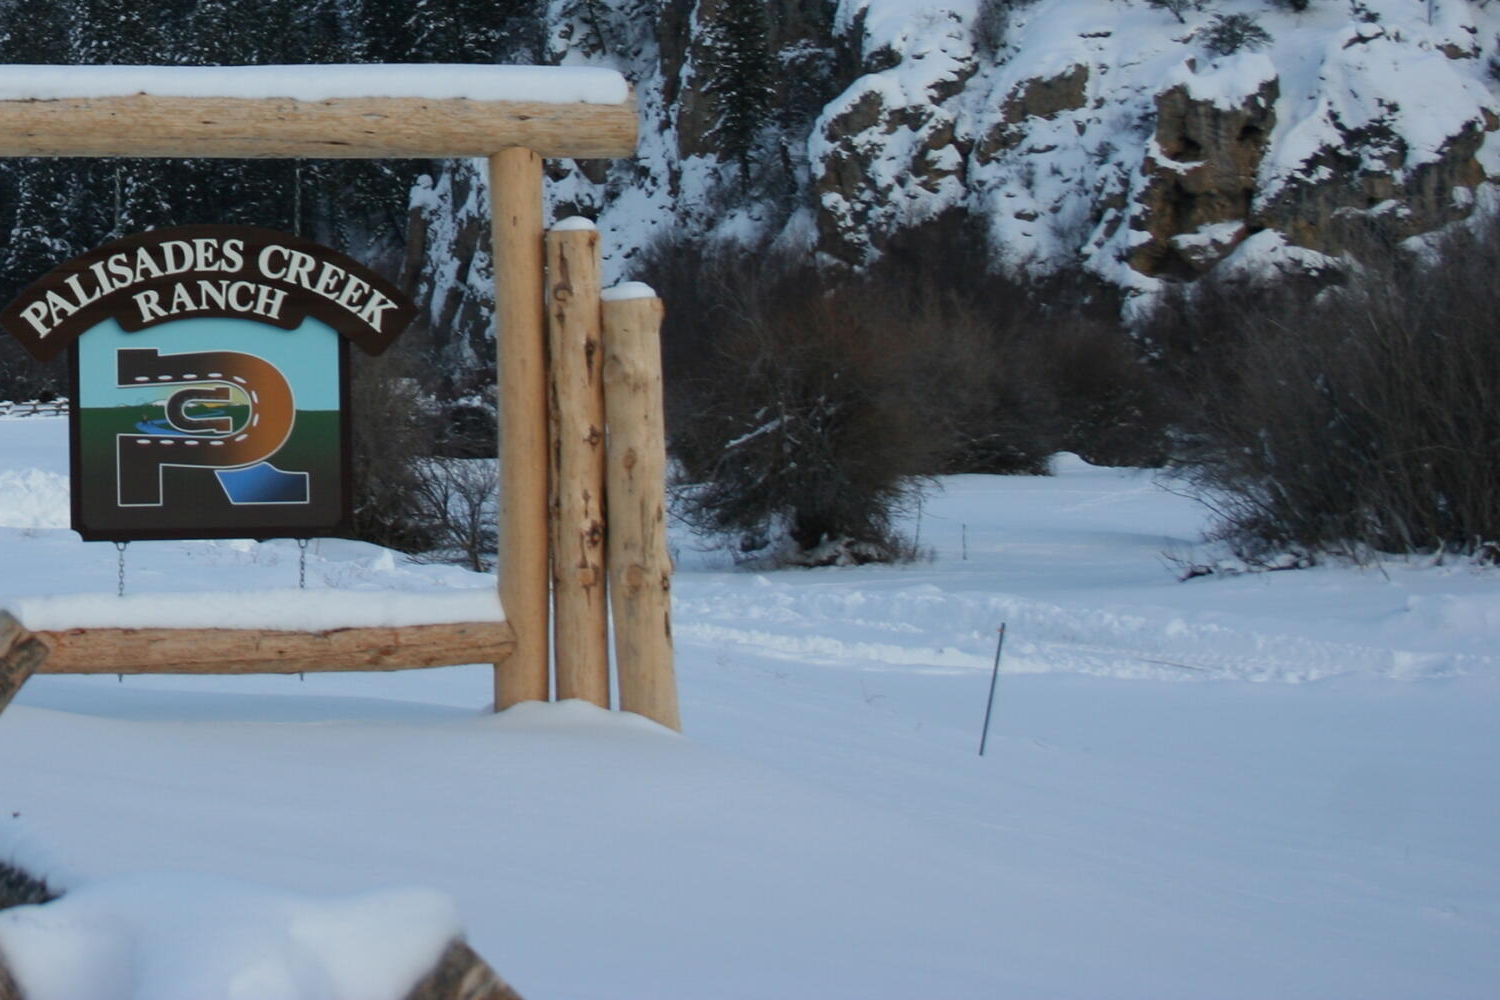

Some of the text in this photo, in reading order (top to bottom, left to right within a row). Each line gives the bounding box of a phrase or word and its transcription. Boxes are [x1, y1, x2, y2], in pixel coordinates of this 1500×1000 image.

[19, 238, 399, 340] PALISADES CREEK
[132, 279, 290, 323] RANCH
